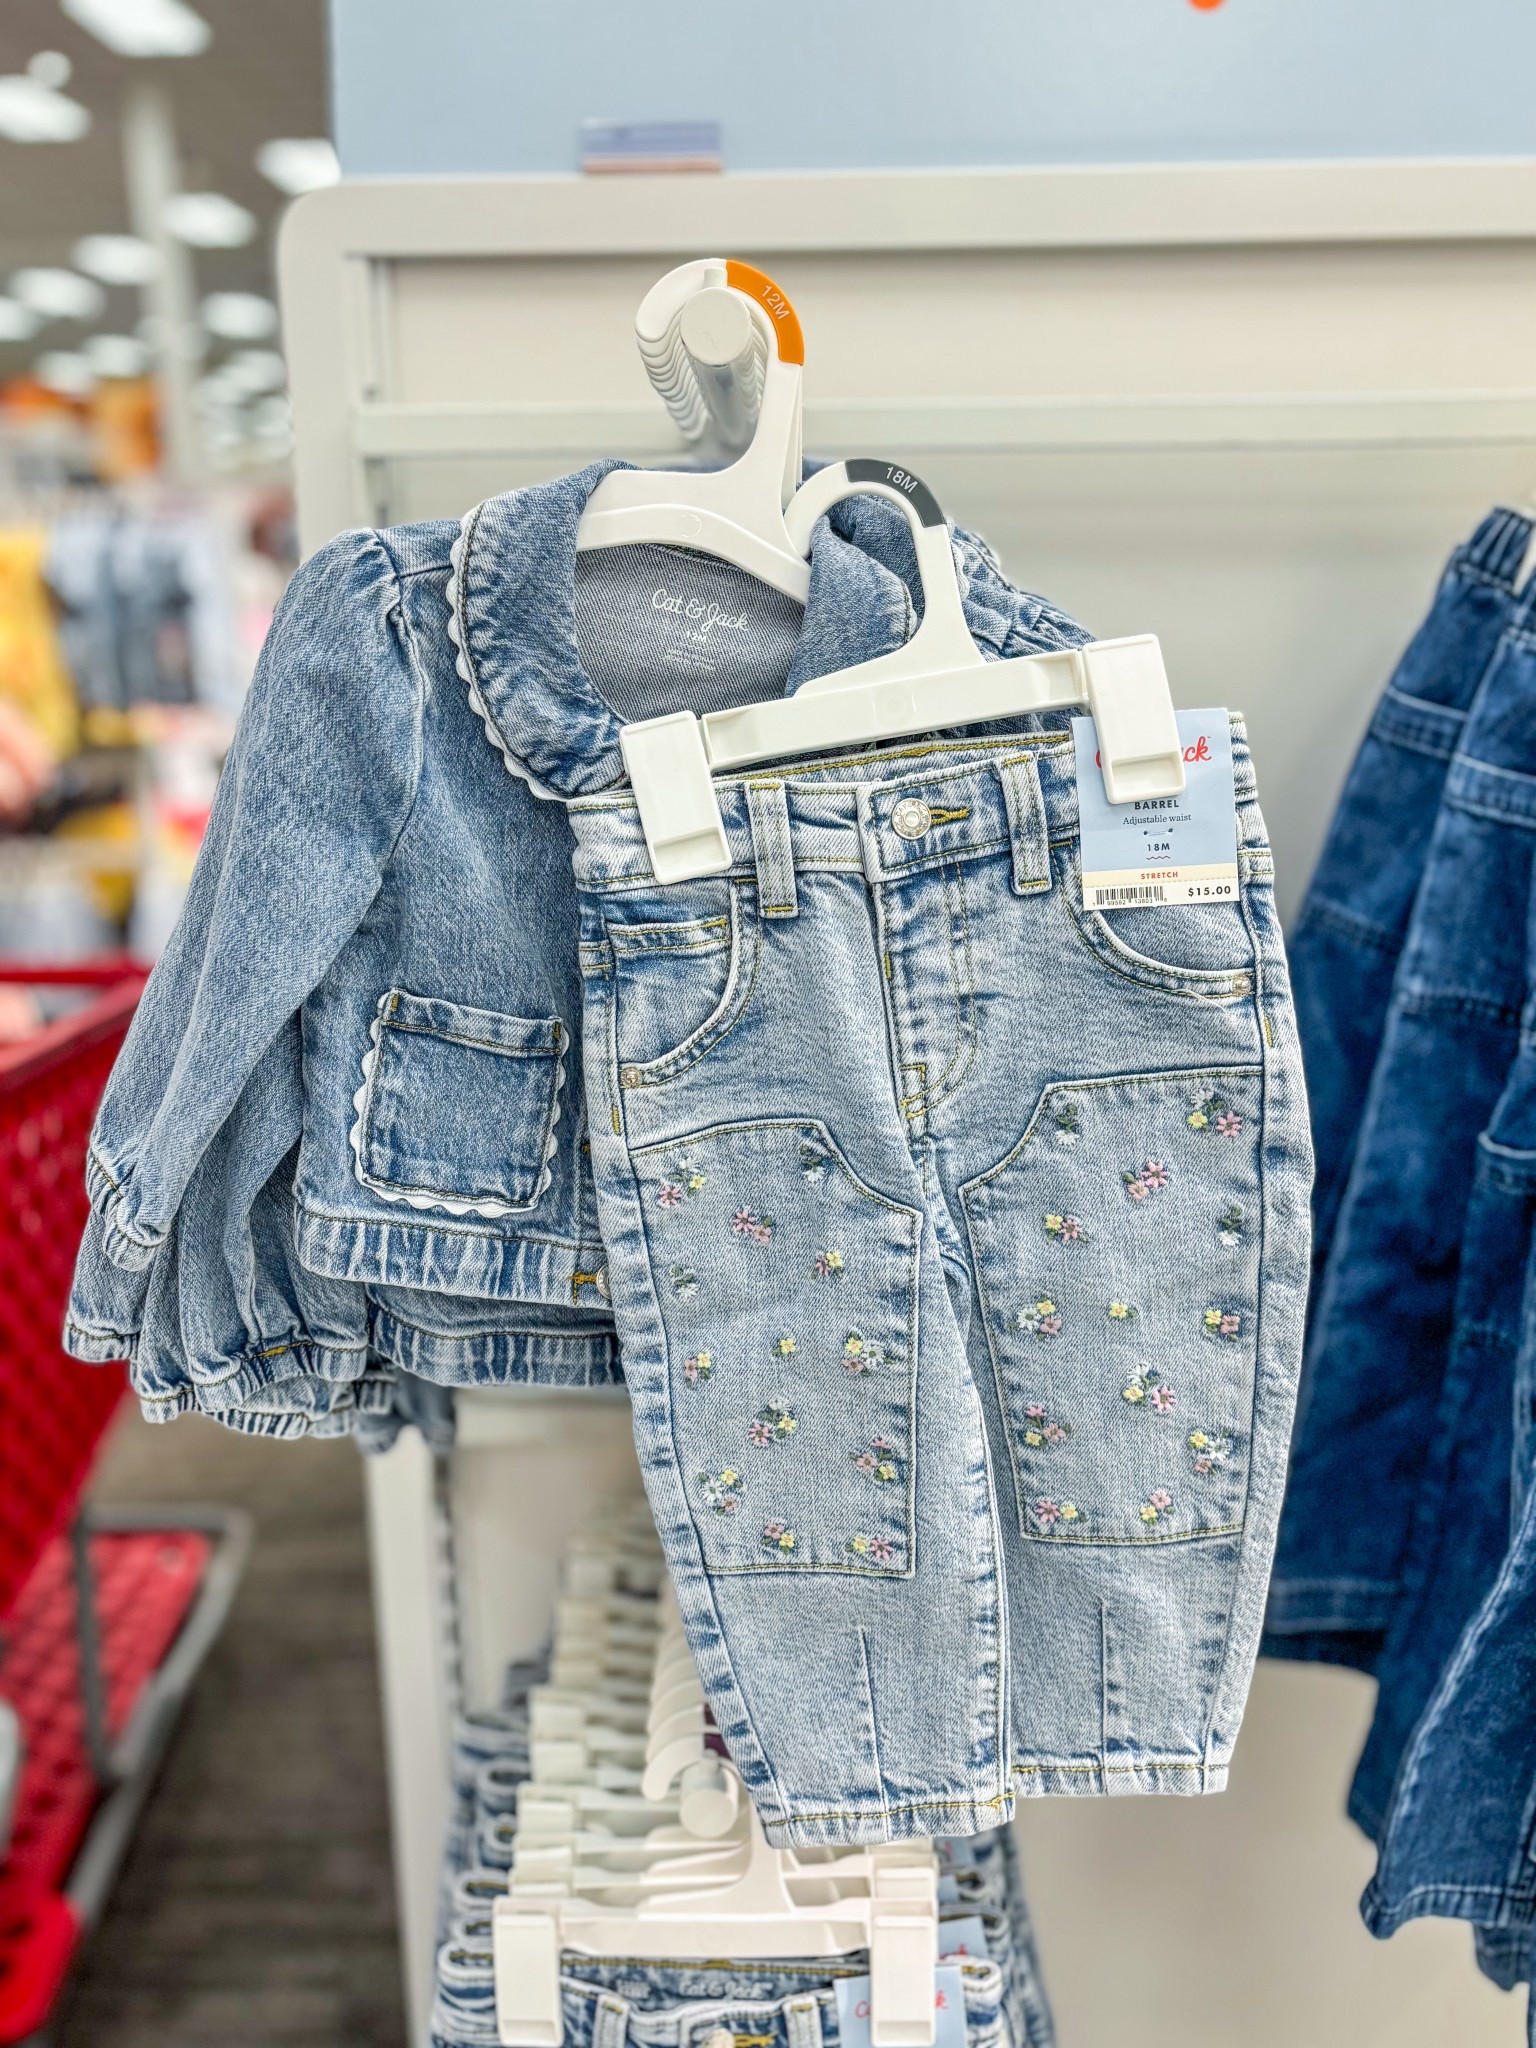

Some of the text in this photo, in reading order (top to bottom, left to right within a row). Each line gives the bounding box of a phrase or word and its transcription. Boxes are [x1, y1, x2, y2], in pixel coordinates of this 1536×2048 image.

[762, 285, 790, 320] 12M
[886, 466, 918, 493] 18M
[652, 588, 749, 632] Cat & Jack
[687, 630, 706, 643] 12M
[1134, 799, 1180, 810] BARREL
[1122, 813, 1192, 826] Adjustable waist
[1147, 842, 1171, 852] 18M
[1140, 871, 1179, 880] STRETCH
[1187, 885, 1231, 898] $15.00
